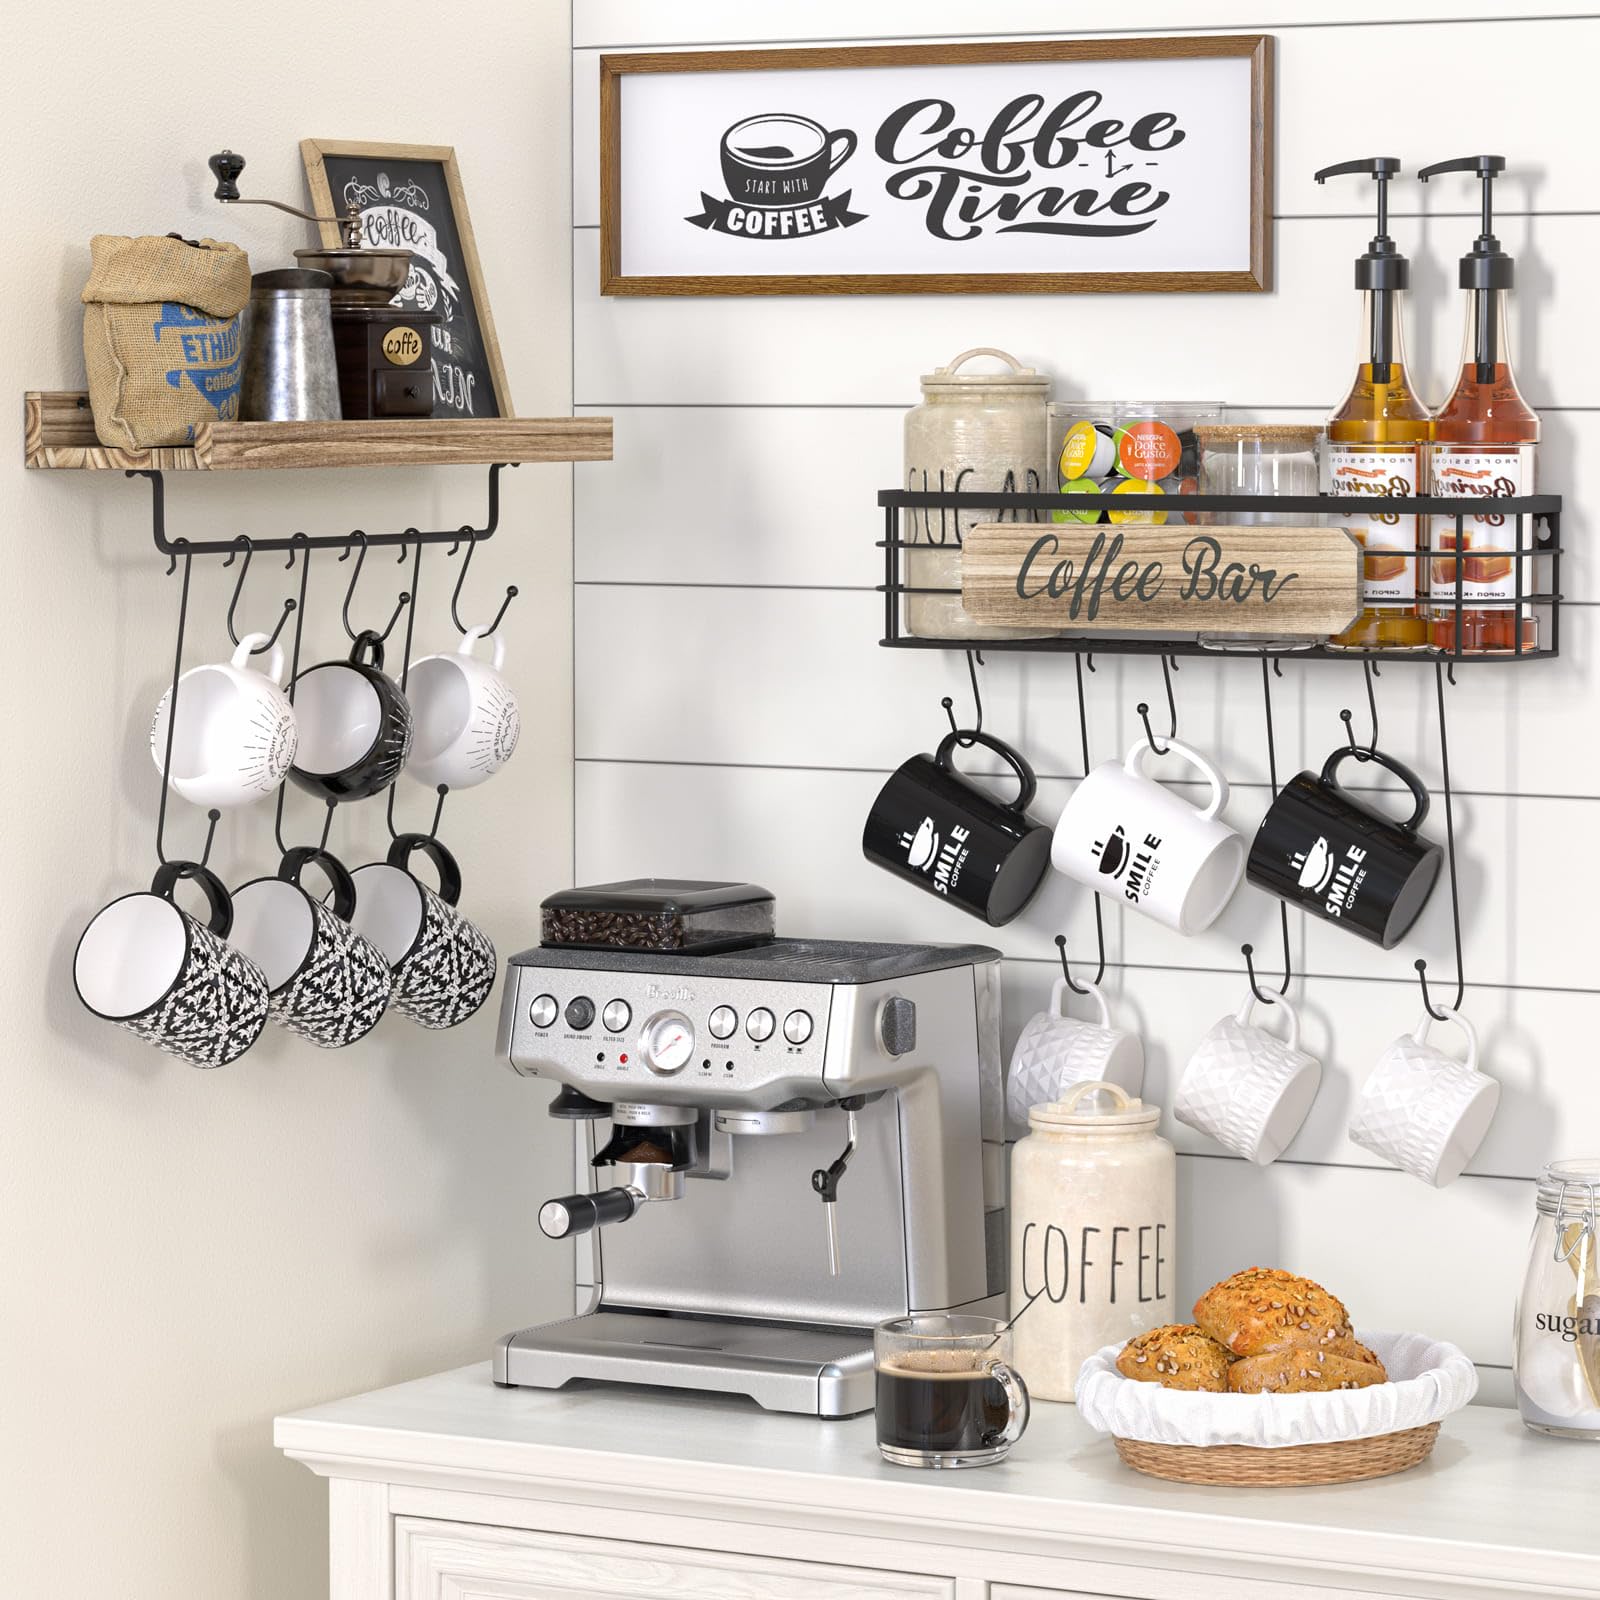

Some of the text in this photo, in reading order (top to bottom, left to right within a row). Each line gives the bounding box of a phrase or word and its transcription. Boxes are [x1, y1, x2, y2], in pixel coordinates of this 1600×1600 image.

[875, 90, 1186, 172] Coffee
[745, 177, 809, 194] START WITH
[885, 164, 1170, 241] Time
[727, 204, 828, 236] COFFEE
[387, 332, 419, 355] coffe
[1134, 440, 1166, 451] Dolce
[1016, 532, 1299, 621] Coffee Bar
[934, 825, 970, 894] SMILE
[950, 848, 969, 887] COFFEE
[1125, 833, 1162, 903] SMILE
[1143, 858, 1161, 896] COFFEE
[1326, 845, 1367, 917] SMILE
[1345, 869, 1367, 909] COFFEE
[1022, 1223, 1166, 1304] COFFEE
